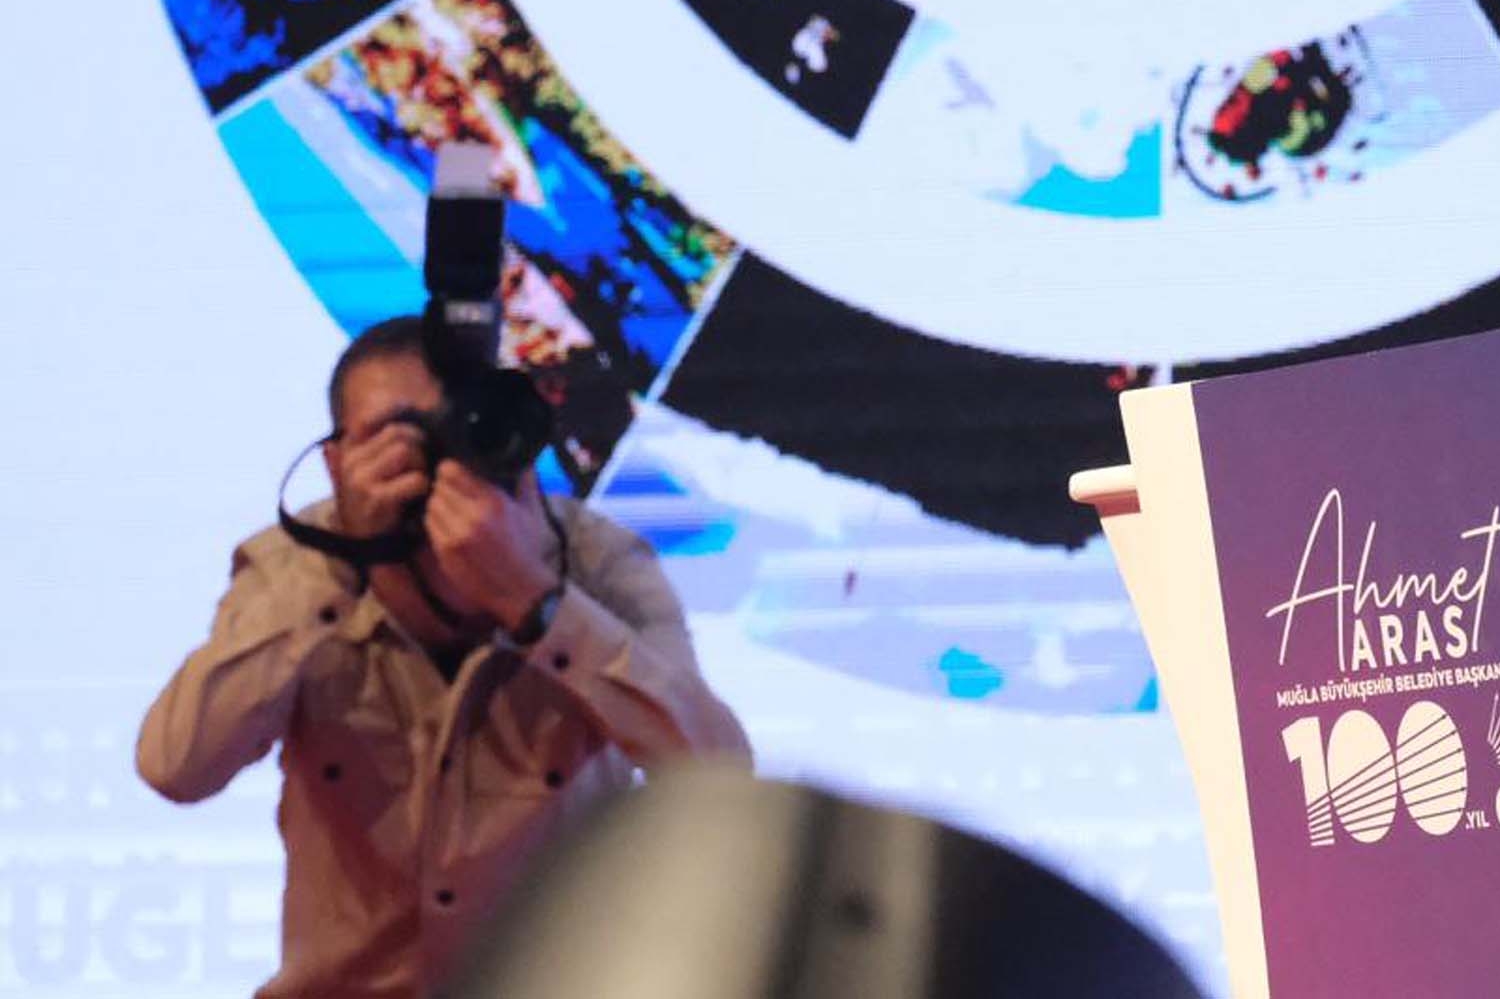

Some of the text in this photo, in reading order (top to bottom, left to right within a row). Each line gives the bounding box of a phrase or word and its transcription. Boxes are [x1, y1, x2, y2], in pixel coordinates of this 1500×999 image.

[1351, 605, 1468, 672] ARAS
[1276, 683, 1319, 708] MUĞLA
[1319, 673, 1394, 703] BÜYÜKŞEHİR
[1395, 665, 1454, 692] BELEDİYE
[1281, 700, 1468, 847] 100
